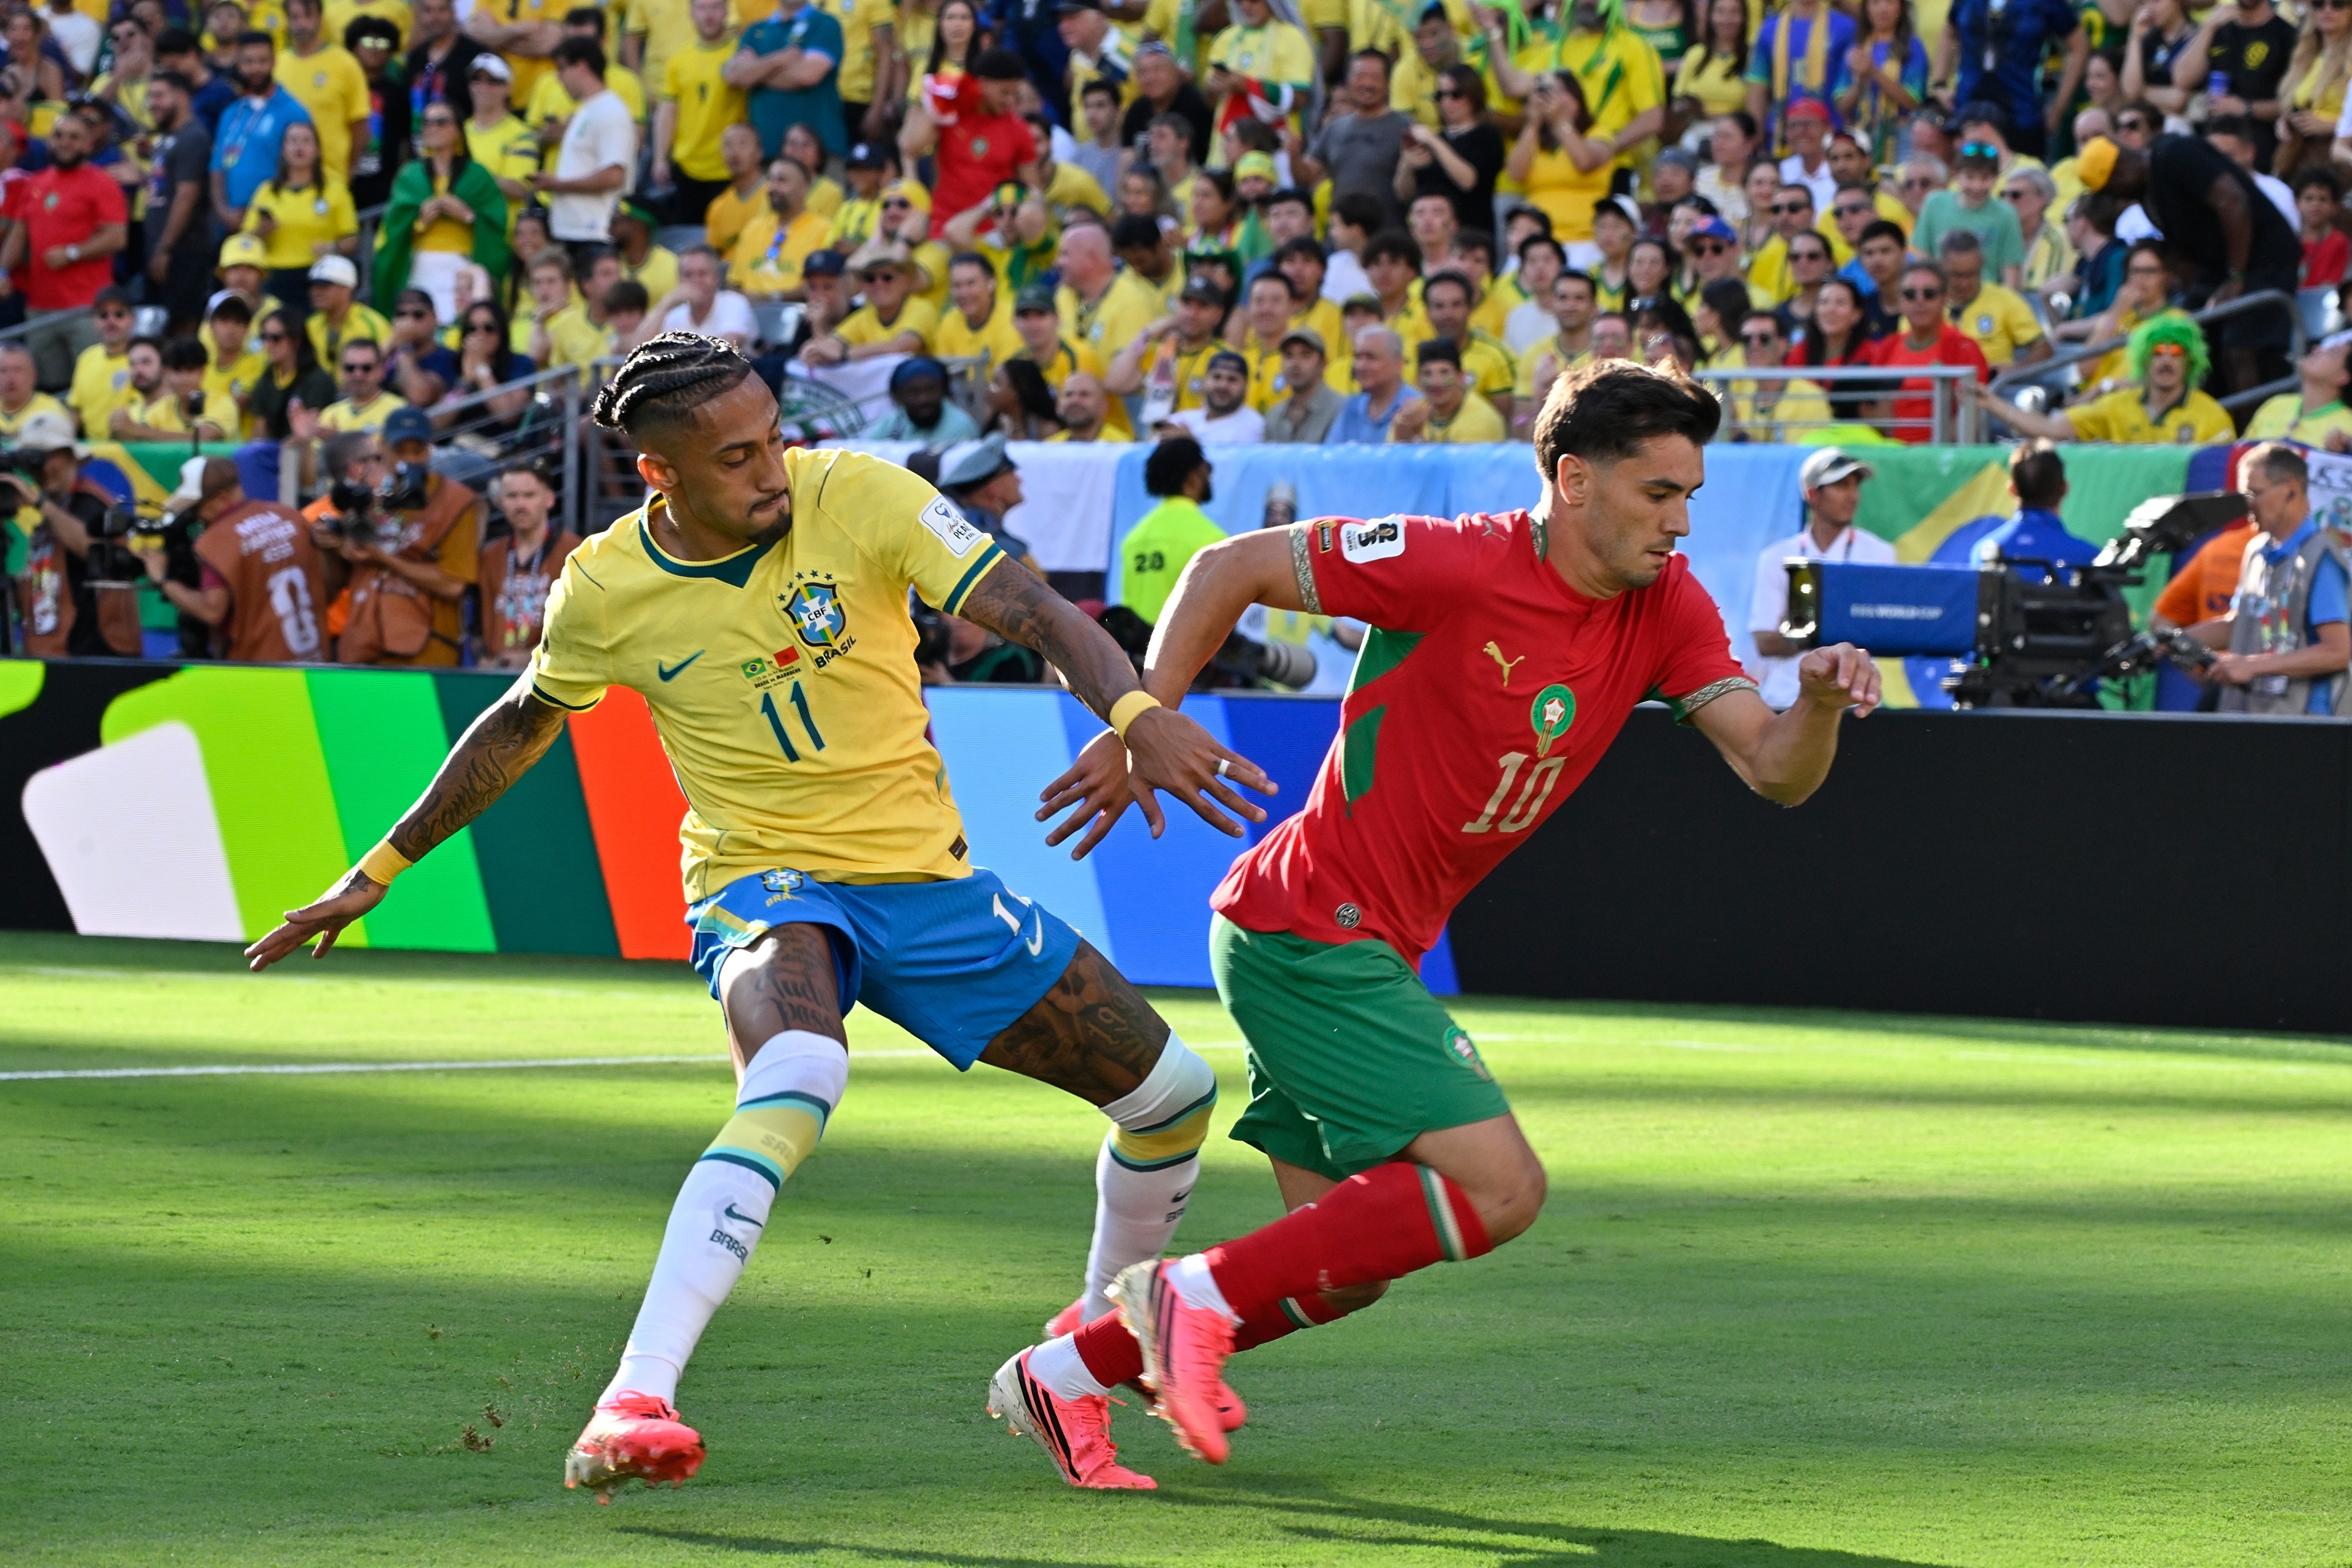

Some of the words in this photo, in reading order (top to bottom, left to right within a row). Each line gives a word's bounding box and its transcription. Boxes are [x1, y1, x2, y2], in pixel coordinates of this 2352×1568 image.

[953, 523, 971, 540] PEAC
[807, 606, 827, 621] CBF
[814, 635, 857, 668] BRASIL
[754, 680, 770, 688] BRASIL
[776, 668, 801, 680] MARROCOS
[760, 680, 827, 764] 11
[1461, 751, 1568, 833] 10
